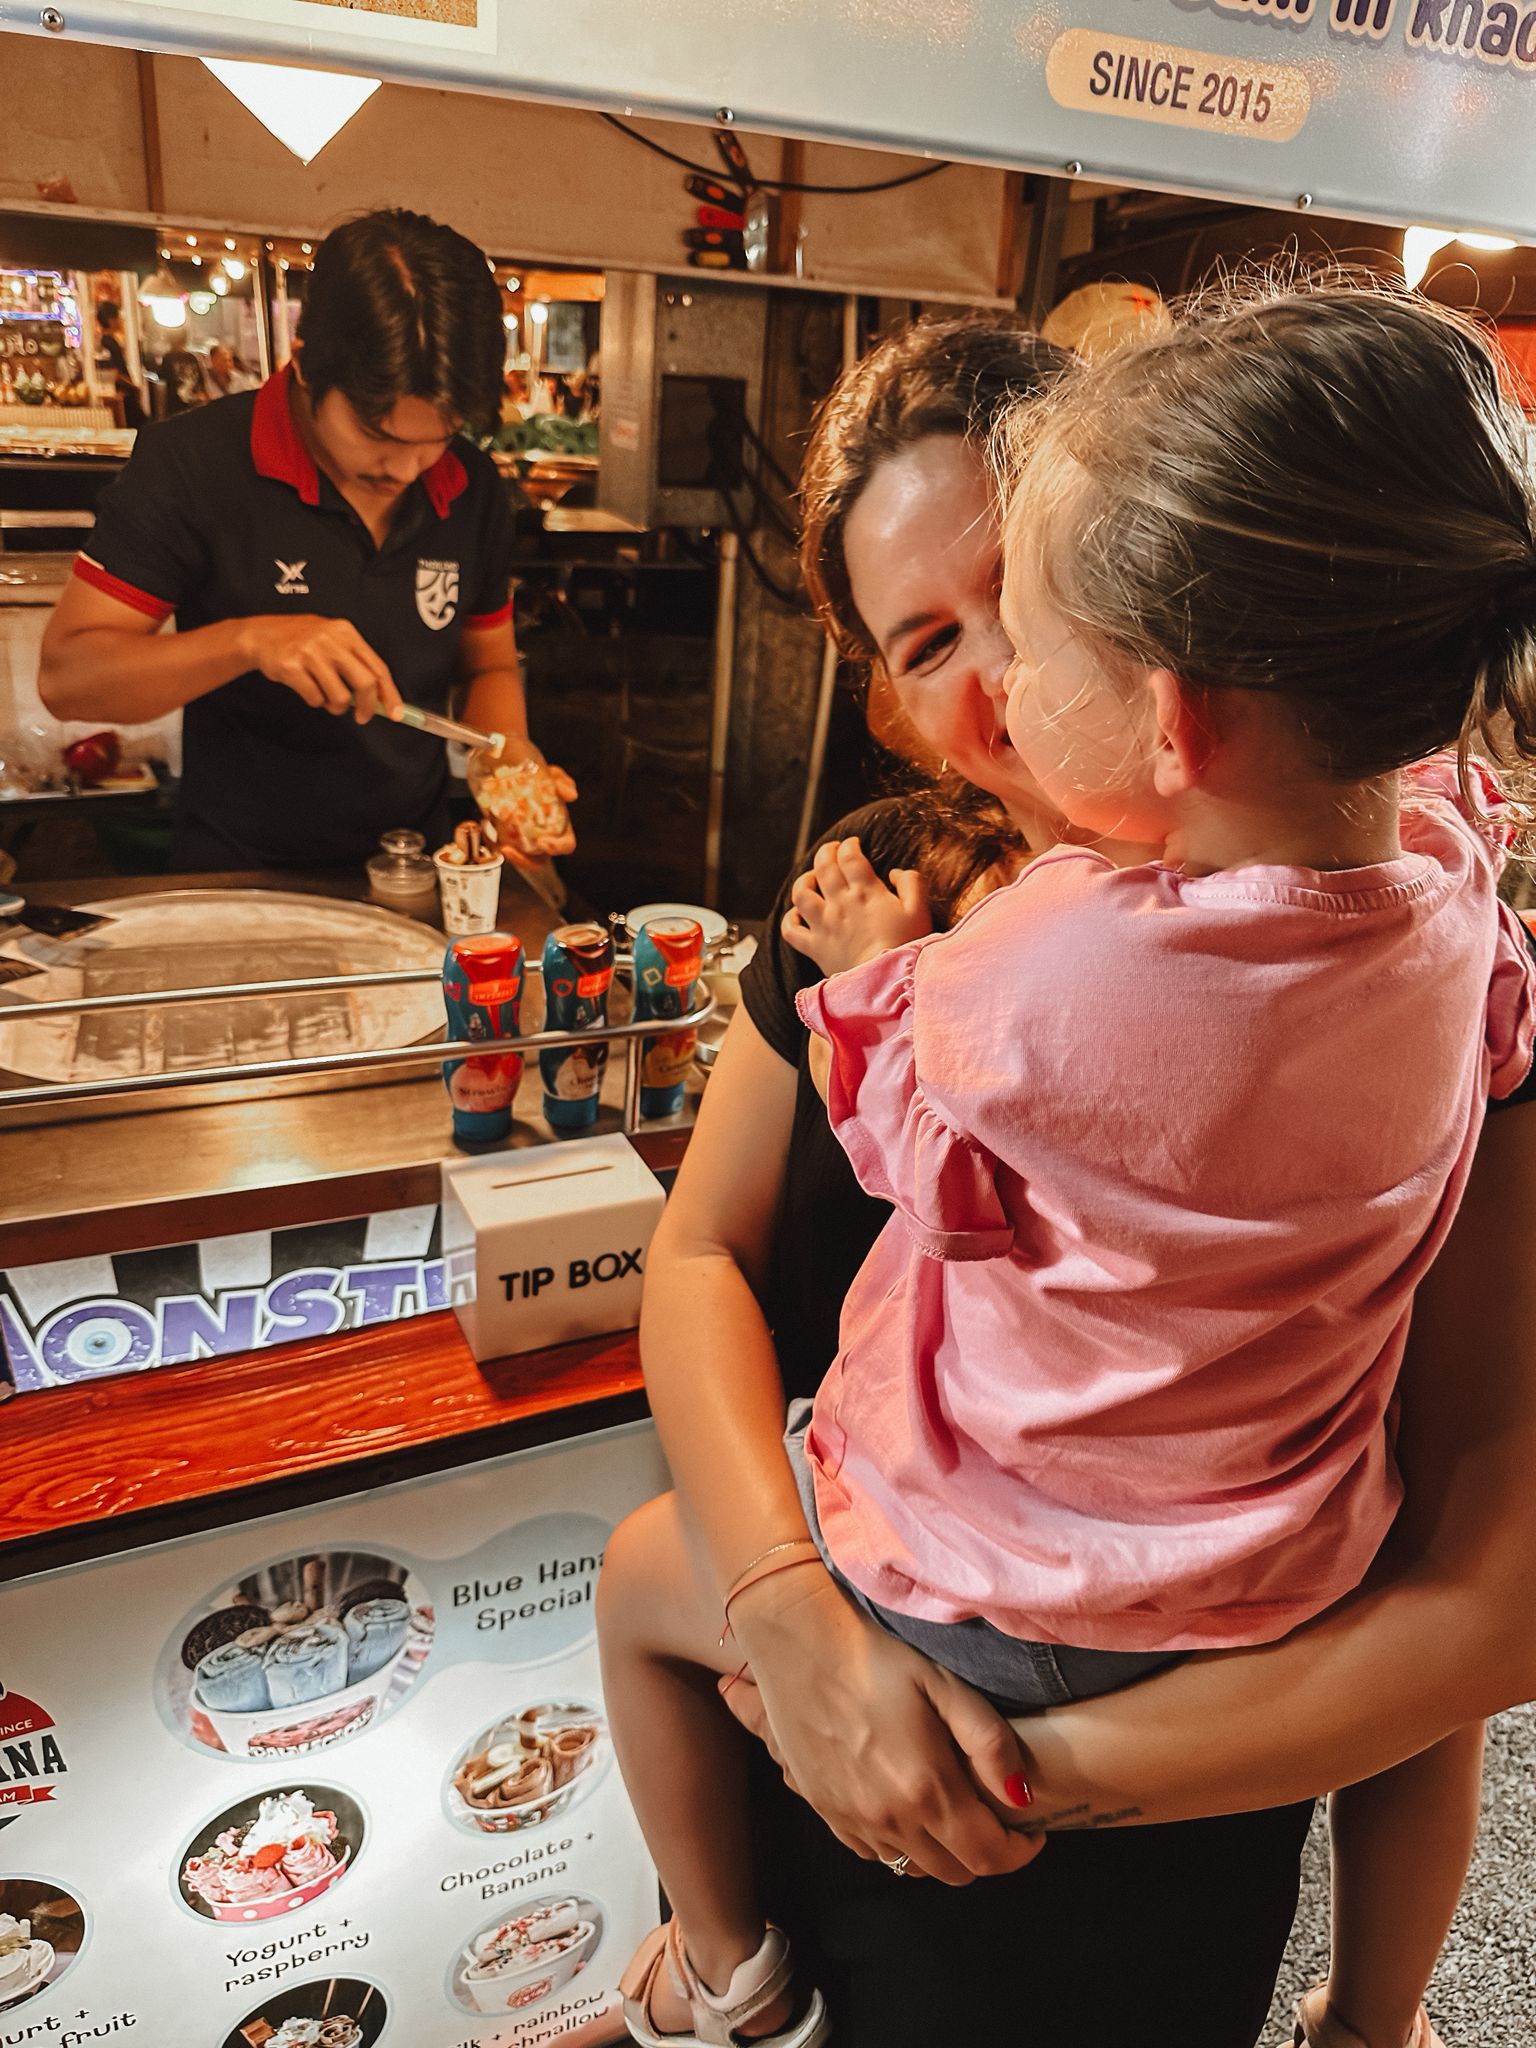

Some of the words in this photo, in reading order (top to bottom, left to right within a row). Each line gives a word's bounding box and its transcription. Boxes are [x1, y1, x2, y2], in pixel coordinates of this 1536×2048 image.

[1089, 50, 1195, 110] SINCE
[1198, 72, 1275, 123] 2015
[498, 1266, 555, 1302] TIP
[568, 1247, 643, 1290] BOX
[453, 1575, 523, 1607] Blue
[476, 1581, 592, 1631] Special
[440, 1838, 573, 1892] Chocolate
[481, 1860, 567, 1900] Banana
[225, 1932, 369, 1993] raspberry
[226, 1923, 327, 1967] Yogurt
[338, 1918, 352, 1928] +
[0, 2016, 61, 2048] urt
[75, 2009, 89, 2019] +
[60, 2012, 137, 2048] fruit
[514, 1991, 605, 2034] rainbow
